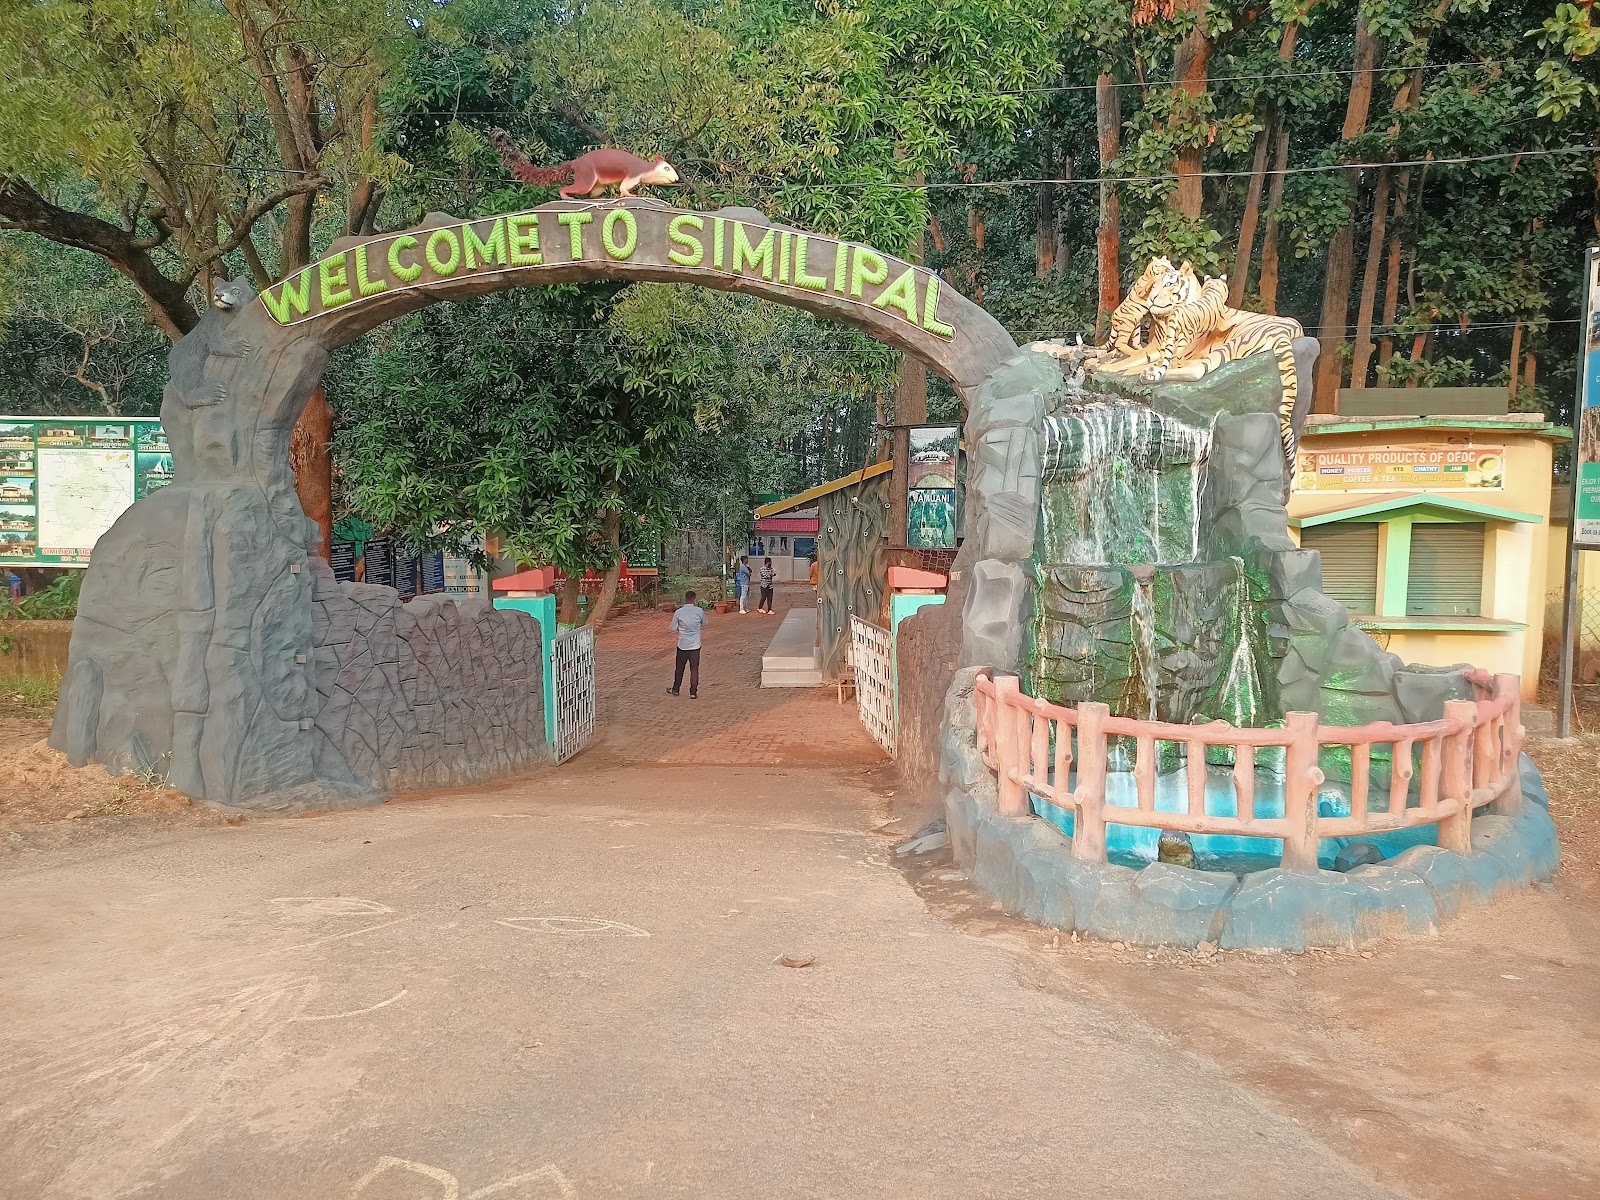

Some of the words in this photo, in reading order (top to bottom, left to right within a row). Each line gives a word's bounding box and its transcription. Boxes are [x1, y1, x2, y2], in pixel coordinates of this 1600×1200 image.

[260, 213, 543, 325] WELCOME
[557, 208, 638, 260] TO
[667, 214, 956, 337] SIMILIPAL
[1318, 453, 1365, 466] QUALITY
[1368, 452, 1426, 465] PRODUCTS
[1429, 452, 1444, 463] OF
[1447, 451, 1476, 463] OFDC
[1582, 478, 1596, 486] ENJOY
[41, 548, 77, 556] SIMILIPAL
